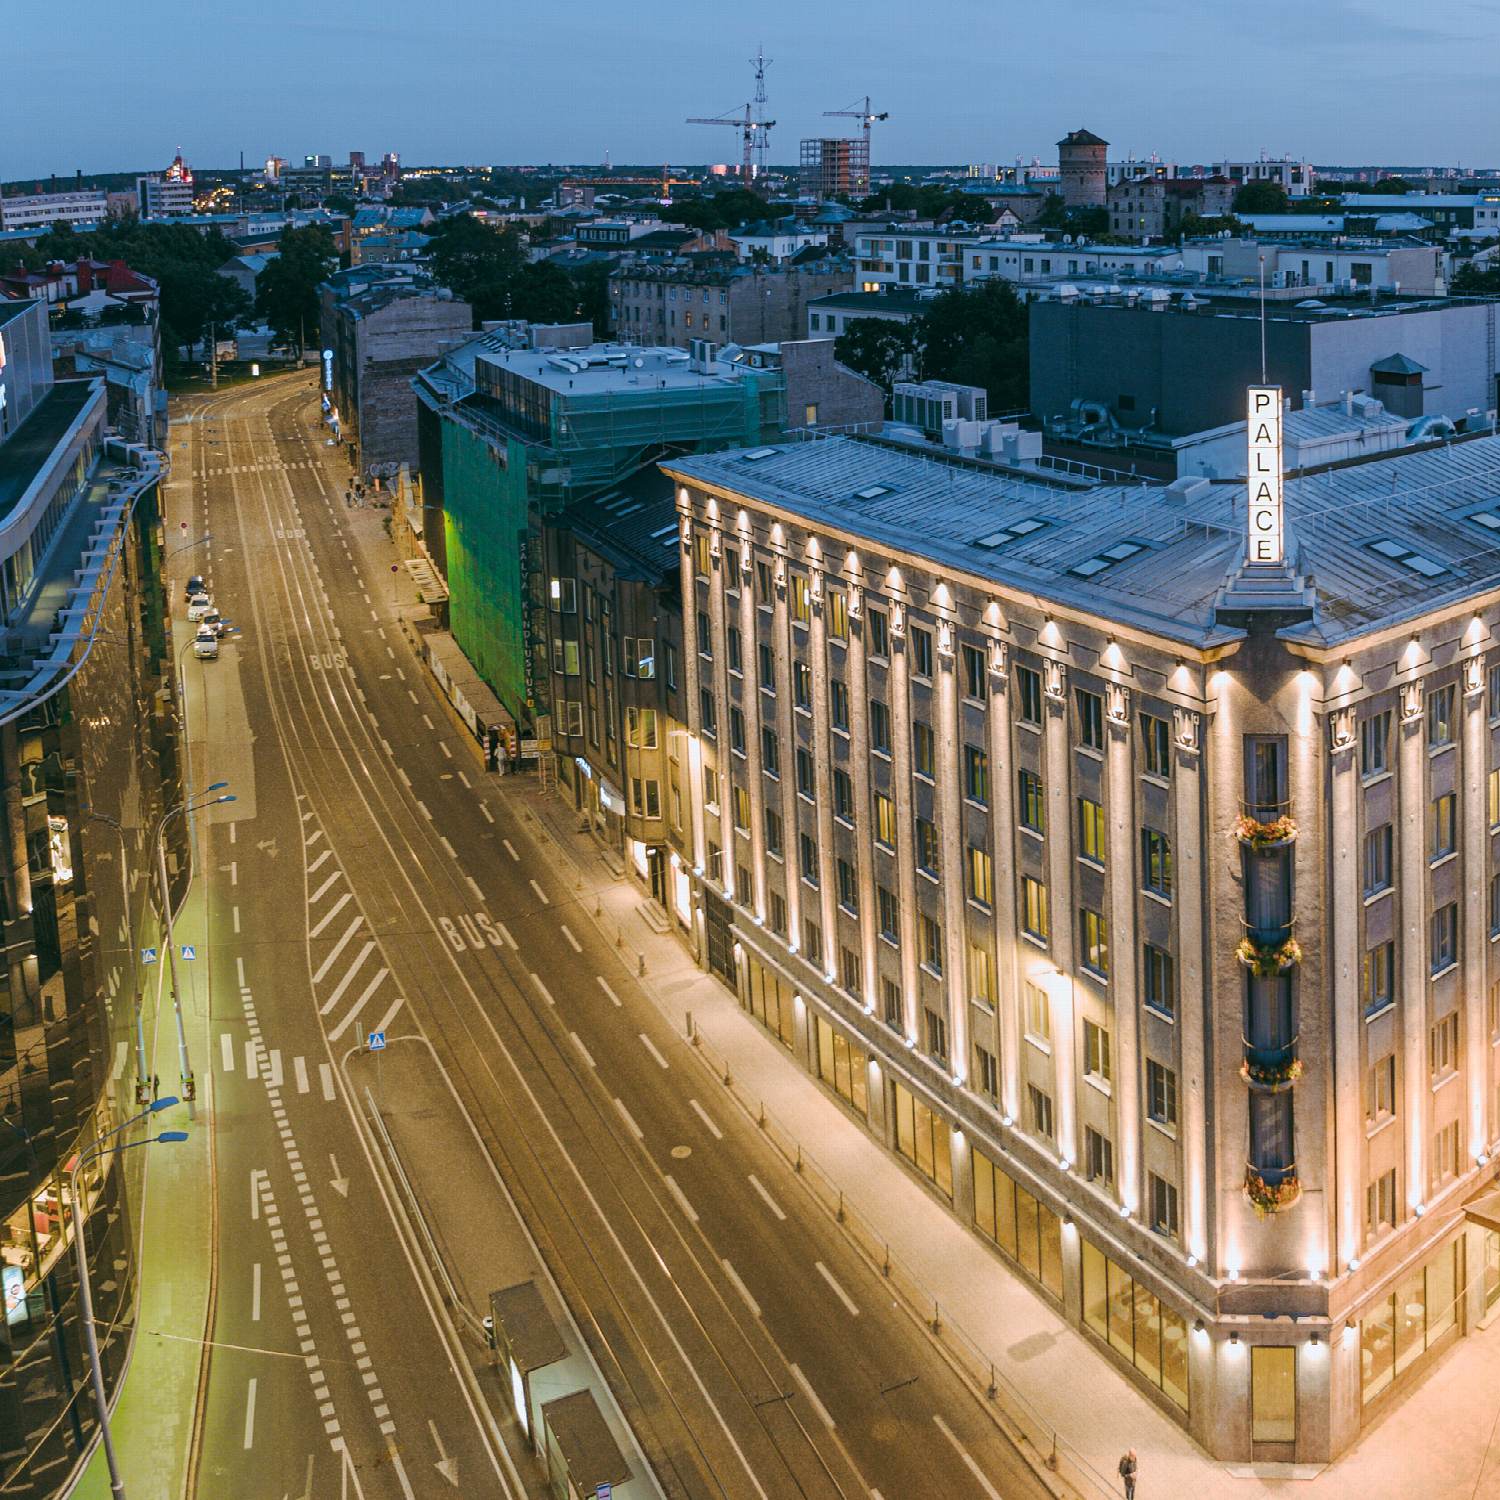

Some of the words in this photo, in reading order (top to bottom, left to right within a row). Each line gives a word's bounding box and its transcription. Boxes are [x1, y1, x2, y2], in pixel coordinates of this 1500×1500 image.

[1254, 393, 1273, 560] PALACE
[520, 543, 529, 590] SALVA
[309, 653, 345, 670] BUS
[522, 601, 534, 697] KINDLUSTUS
[438, 912, 503, 952] BUS
